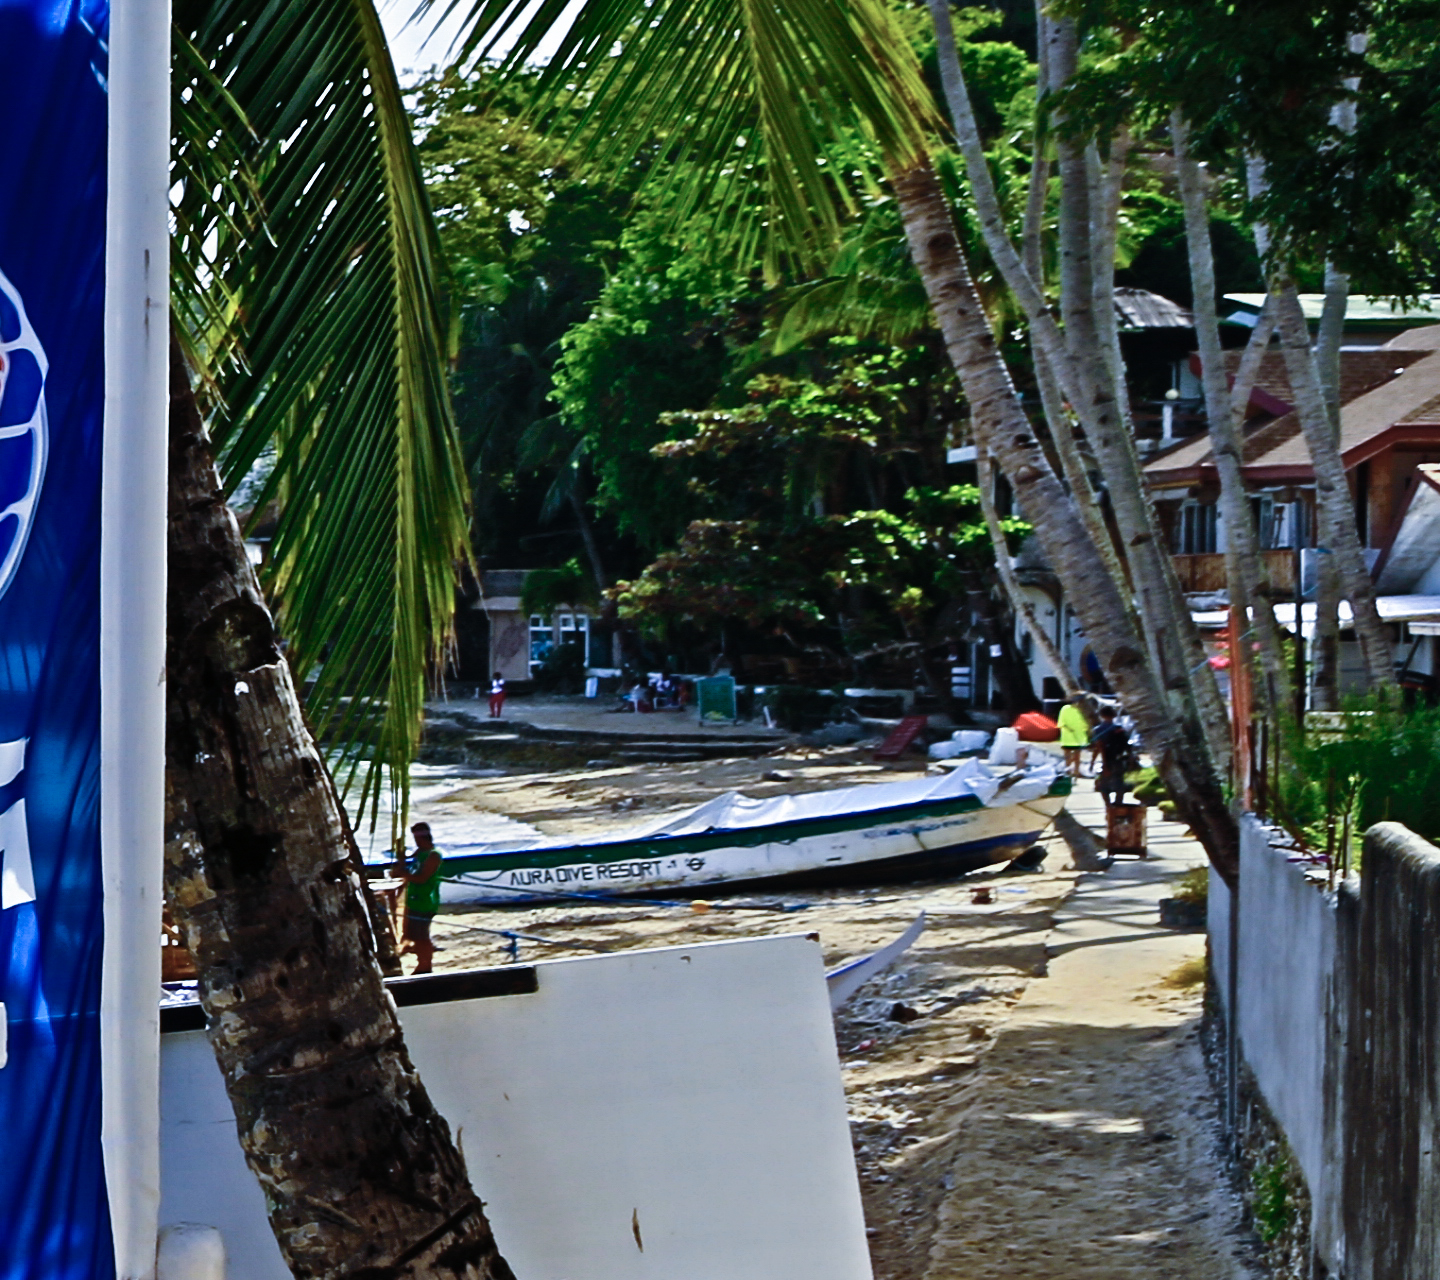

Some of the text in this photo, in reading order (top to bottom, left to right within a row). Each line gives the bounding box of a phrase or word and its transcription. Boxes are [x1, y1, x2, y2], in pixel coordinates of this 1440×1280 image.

[510, 871, 554, 886] AURA
[556, 865, 594, 882] DIVE
[598, 860, 661, 880] RESORT
